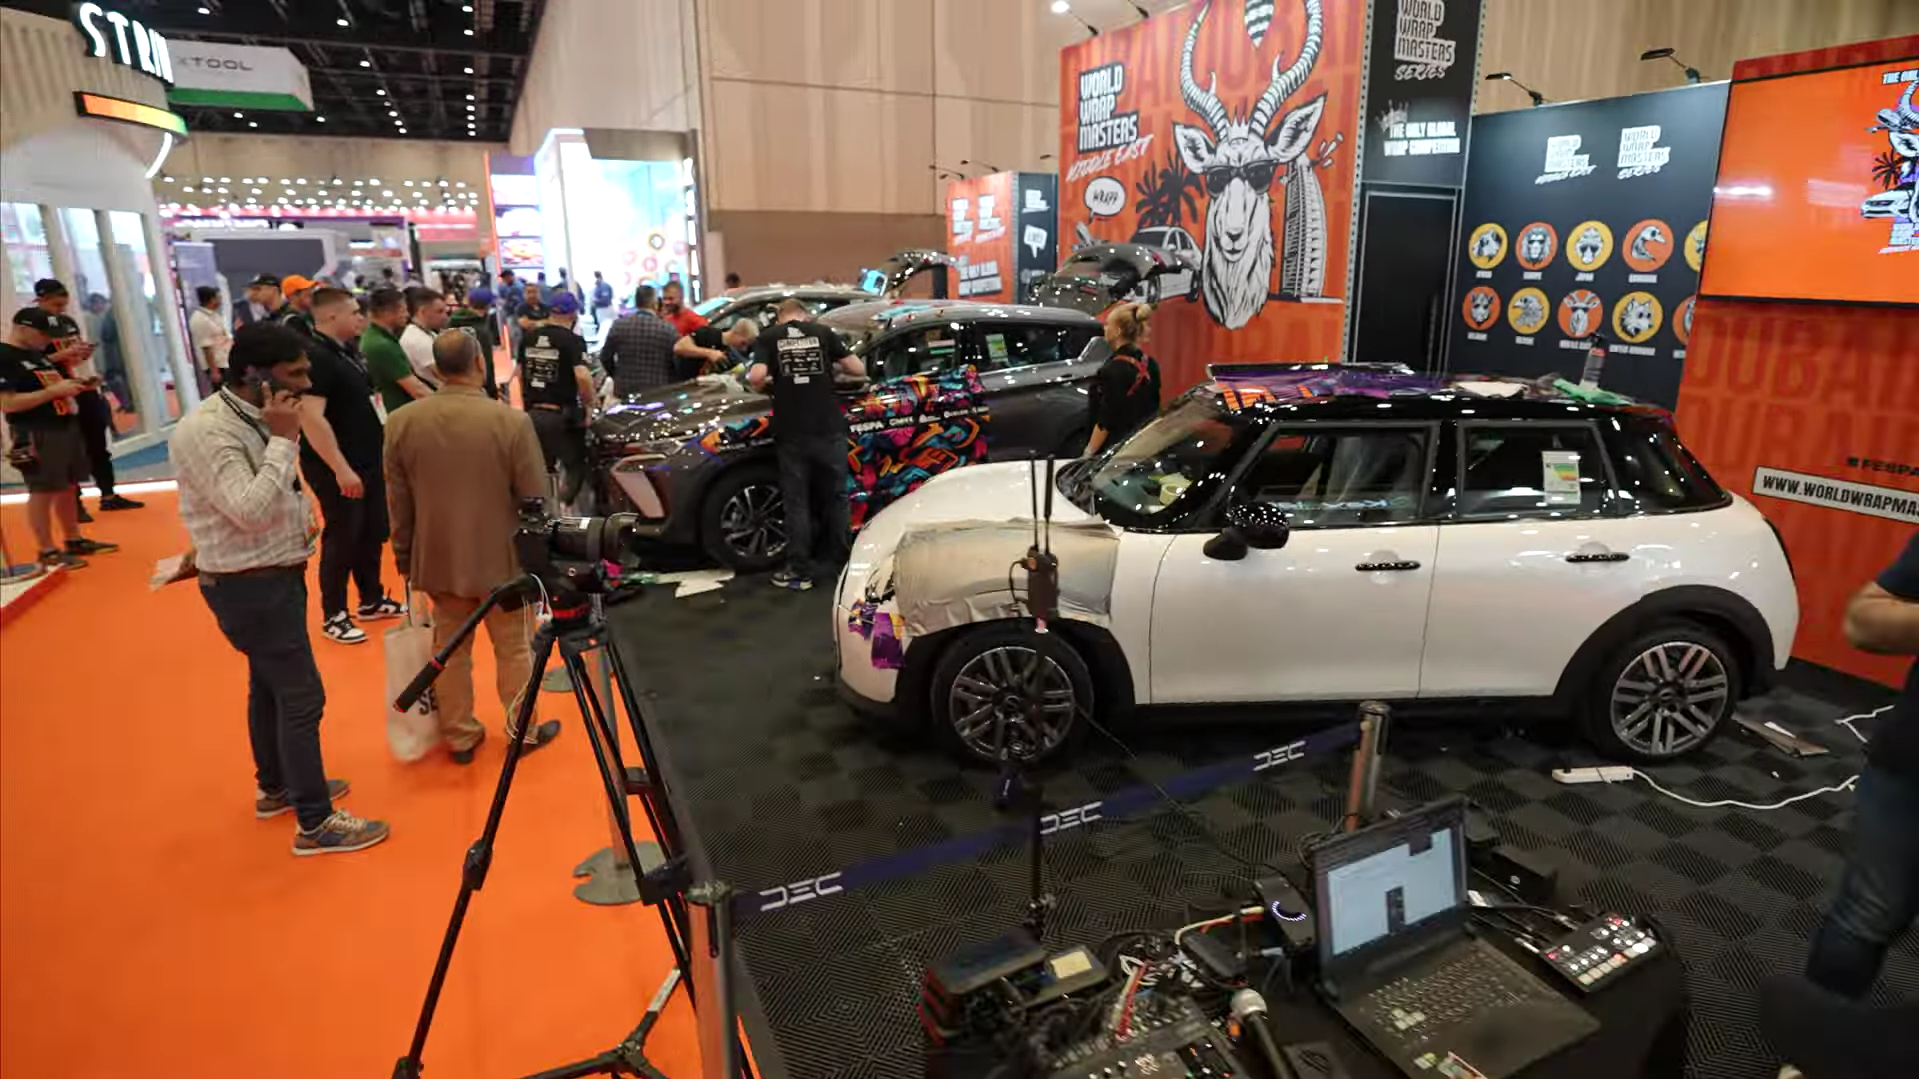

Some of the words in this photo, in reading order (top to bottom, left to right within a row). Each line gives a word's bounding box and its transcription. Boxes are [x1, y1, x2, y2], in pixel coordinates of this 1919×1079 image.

[1402, 0, 1443, 21] WORLD
[1401, 18, 1434, 39] WRAP
[1398, 37, 1452, 62] MASTERS
[1080, 65, 1123, 99] WORLD
[1395, 63, 1446, 80] SERIES
[1080, 94, 1116, 125] WRAP
[1079, 115, 1139, 150] MASTERS
